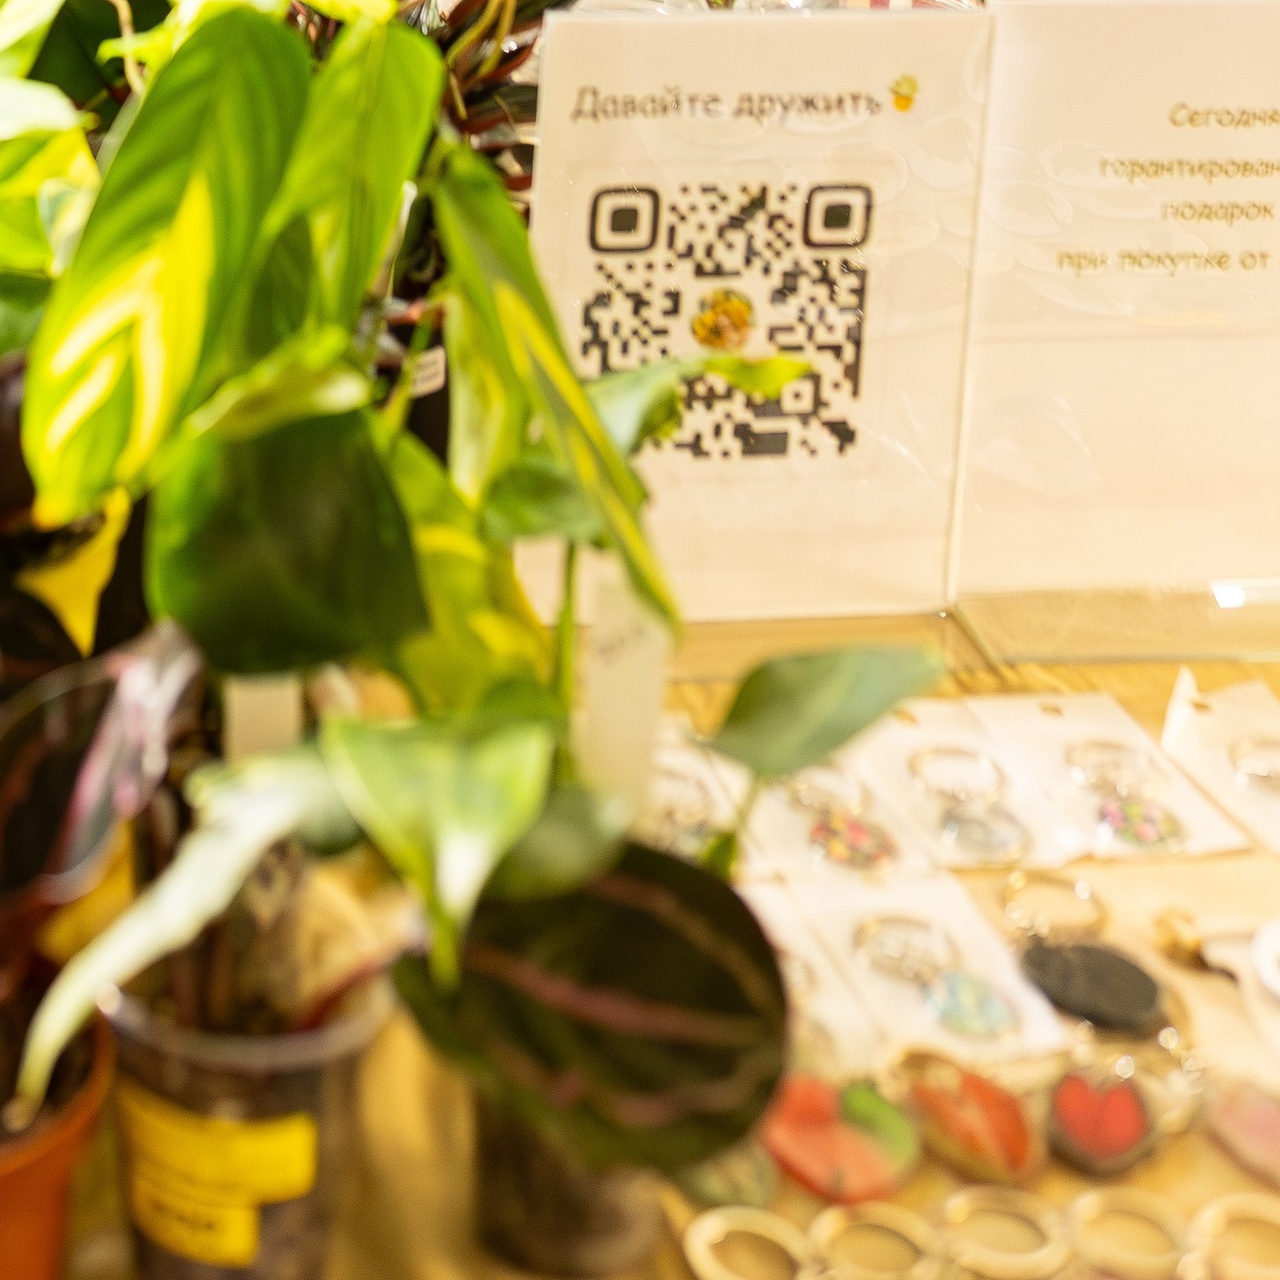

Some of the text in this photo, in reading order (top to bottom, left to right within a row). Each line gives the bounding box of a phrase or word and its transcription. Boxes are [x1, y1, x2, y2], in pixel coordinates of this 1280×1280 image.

[570, 83, 883, 126] Давайте дружить
[1161, 201, 1274, 227] подарок
[1055, 250, 1269, 278] при покупке от
